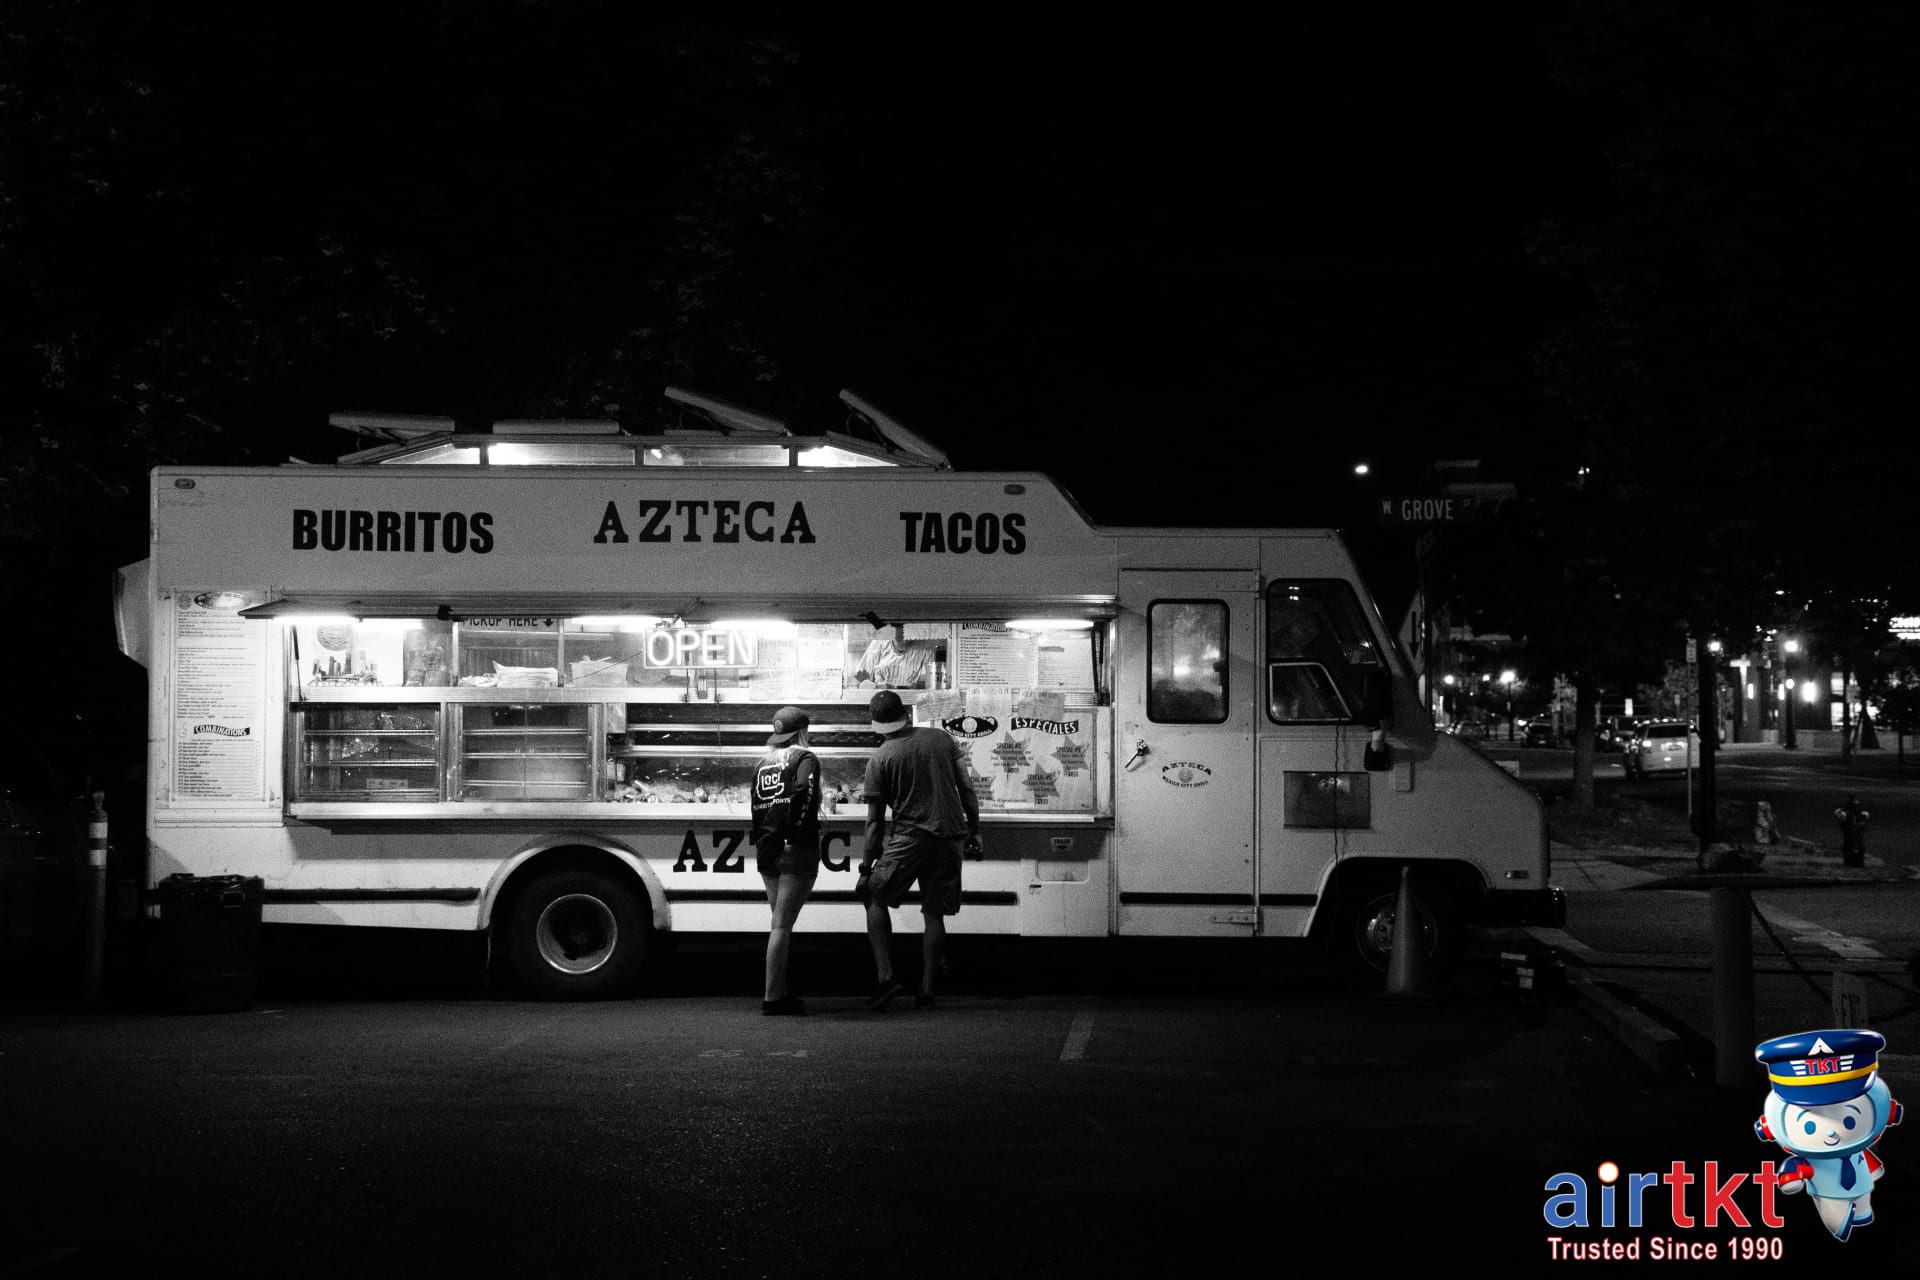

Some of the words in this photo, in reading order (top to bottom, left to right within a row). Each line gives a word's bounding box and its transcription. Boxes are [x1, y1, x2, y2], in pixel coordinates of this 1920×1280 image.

[594, 500, 816, 543] AZTECA
[1402, 499, 1454, 520] GROVE
[293, 509, 494, 553] BURRITOS
[900, 512, 1026, 554] TACOS
[648, 630, 755, 666] OPEN
[194, 725, 250, 737] COMBINATIONS
[1015, 717, 1077, 735] ESPECIALES
[1162, 761, 1211, 775] AZTECA
